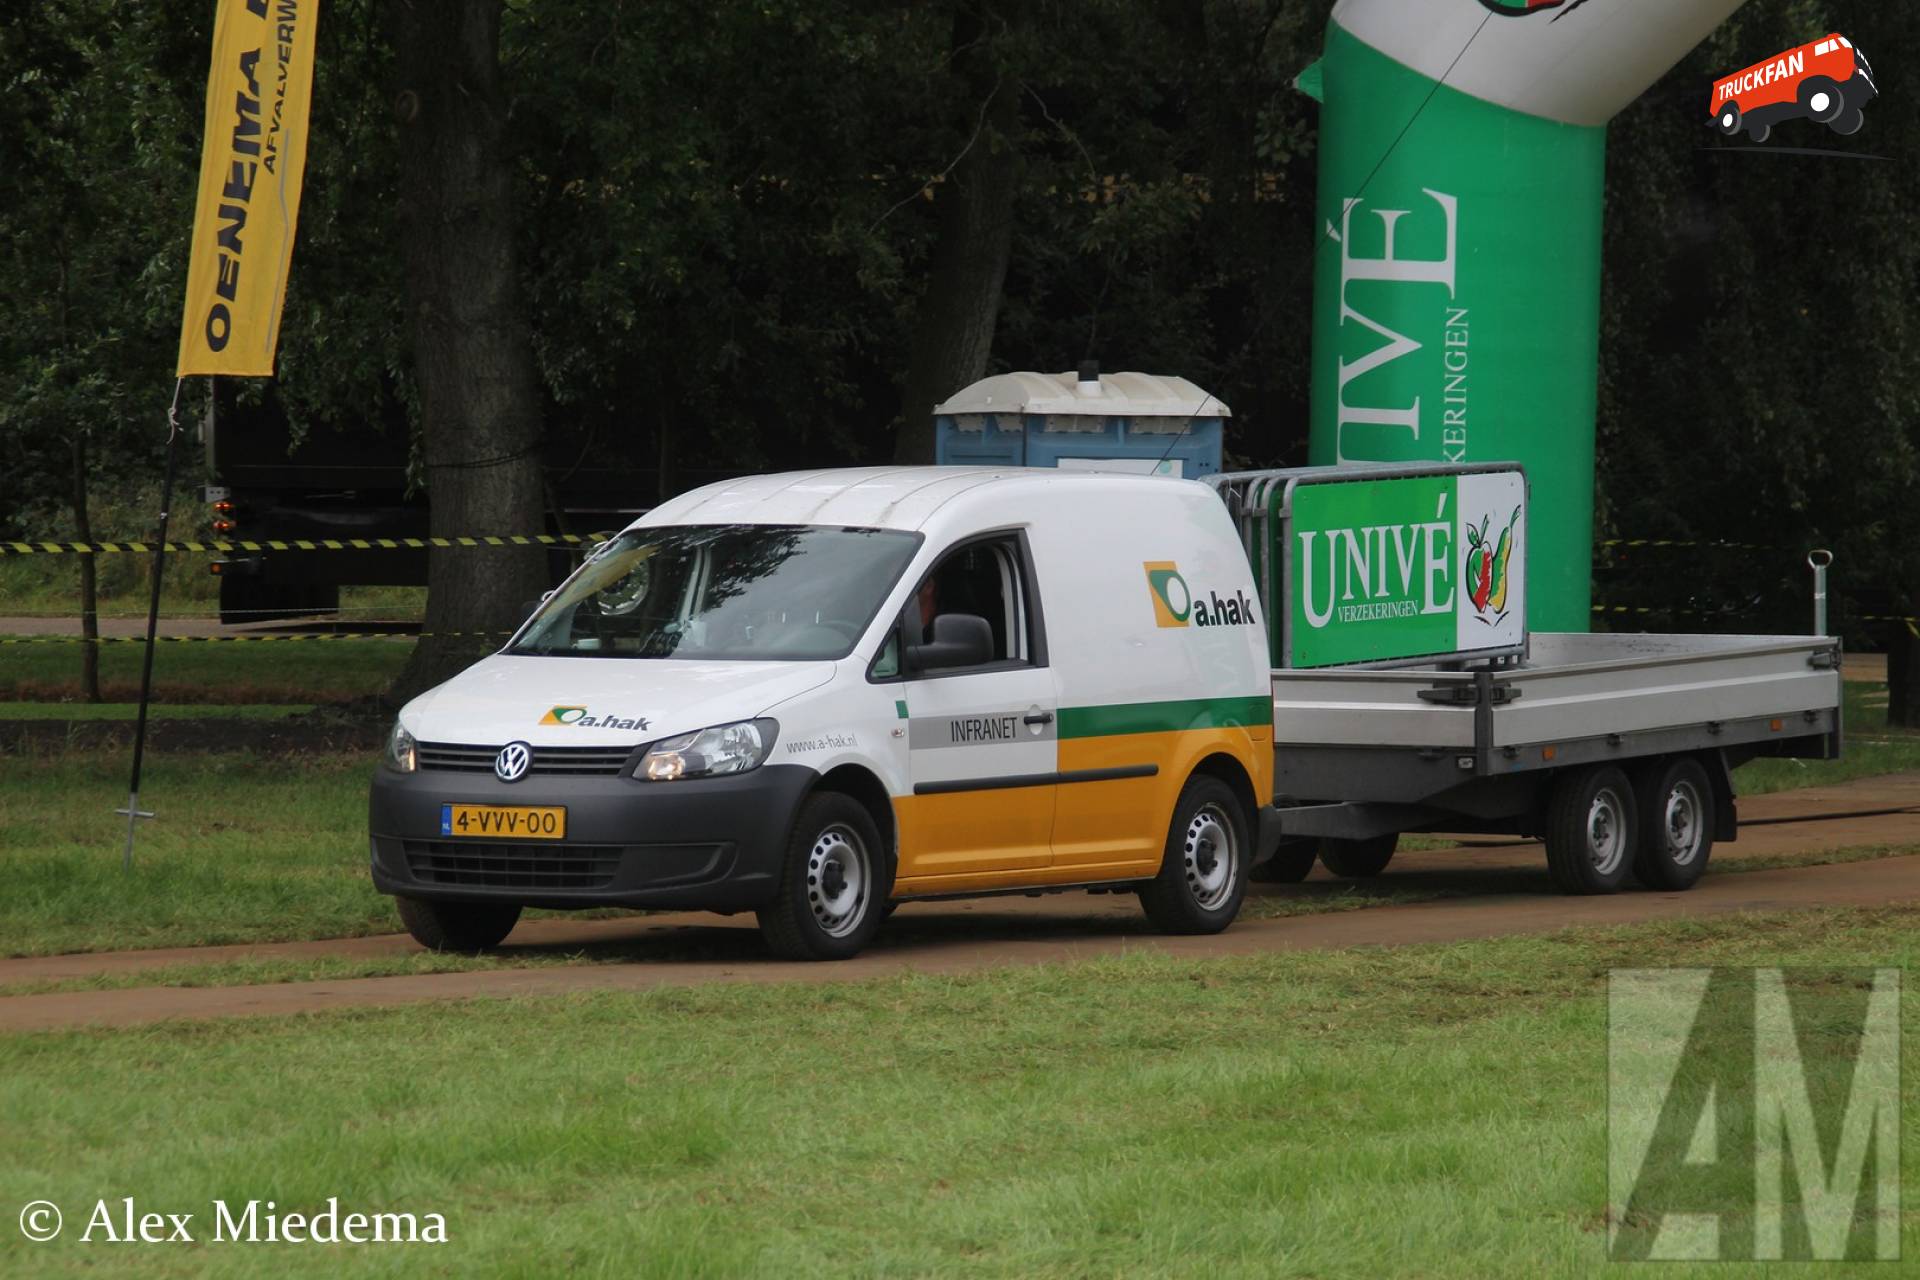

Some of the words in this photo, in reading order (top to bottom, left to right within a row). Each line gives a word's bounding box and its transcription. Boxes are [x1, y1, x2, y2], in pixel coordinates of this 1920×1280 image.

[206, 48, 261, 352] OENEMA
[1326, 187, 1458, 464] IVÉ
[1298, 493, 1454, 628] UNIVÉ
[1194, 589, 1256, 627] a.hak
[1338, 600, 1419, 622] VERZEKERINGEN
[578, 715, 653, 731] a.hak
[951, 716, 1018, 742] INFRANET
[786, 733, 858, 754] www.a-hak.nl
[457, 810, 556, 833] 4-VVV-00
